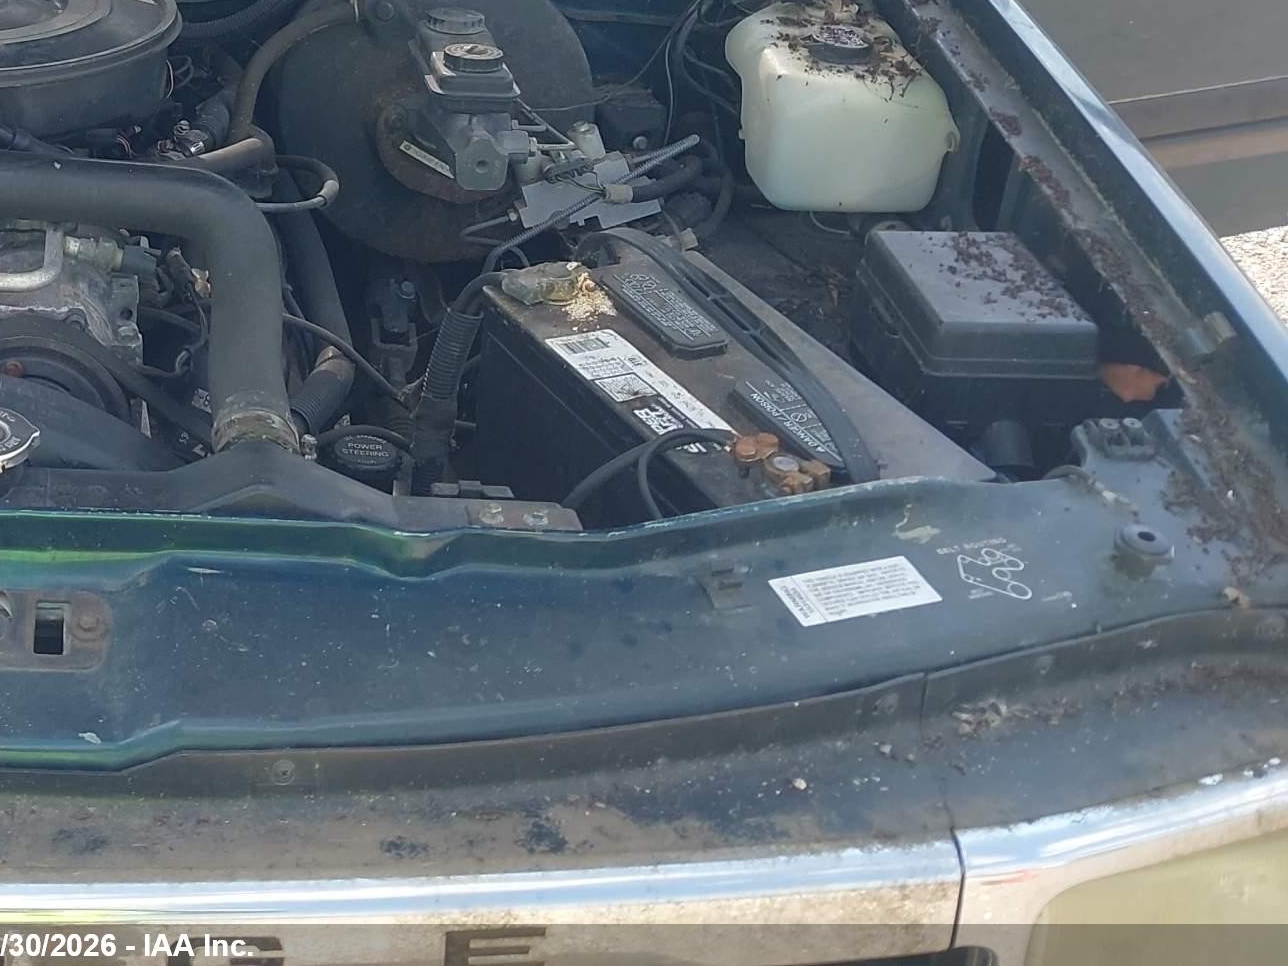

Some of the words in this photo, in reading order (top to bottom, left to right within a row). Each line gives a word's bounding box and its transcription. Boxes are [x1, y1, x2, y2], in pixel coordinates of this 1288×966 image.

[750, 393, 783, 417] POISON
[783, 421, 818, 447] DANGER
[342, 448, 390, 457] STEERING
[347, 442, 383, 451] POWER
